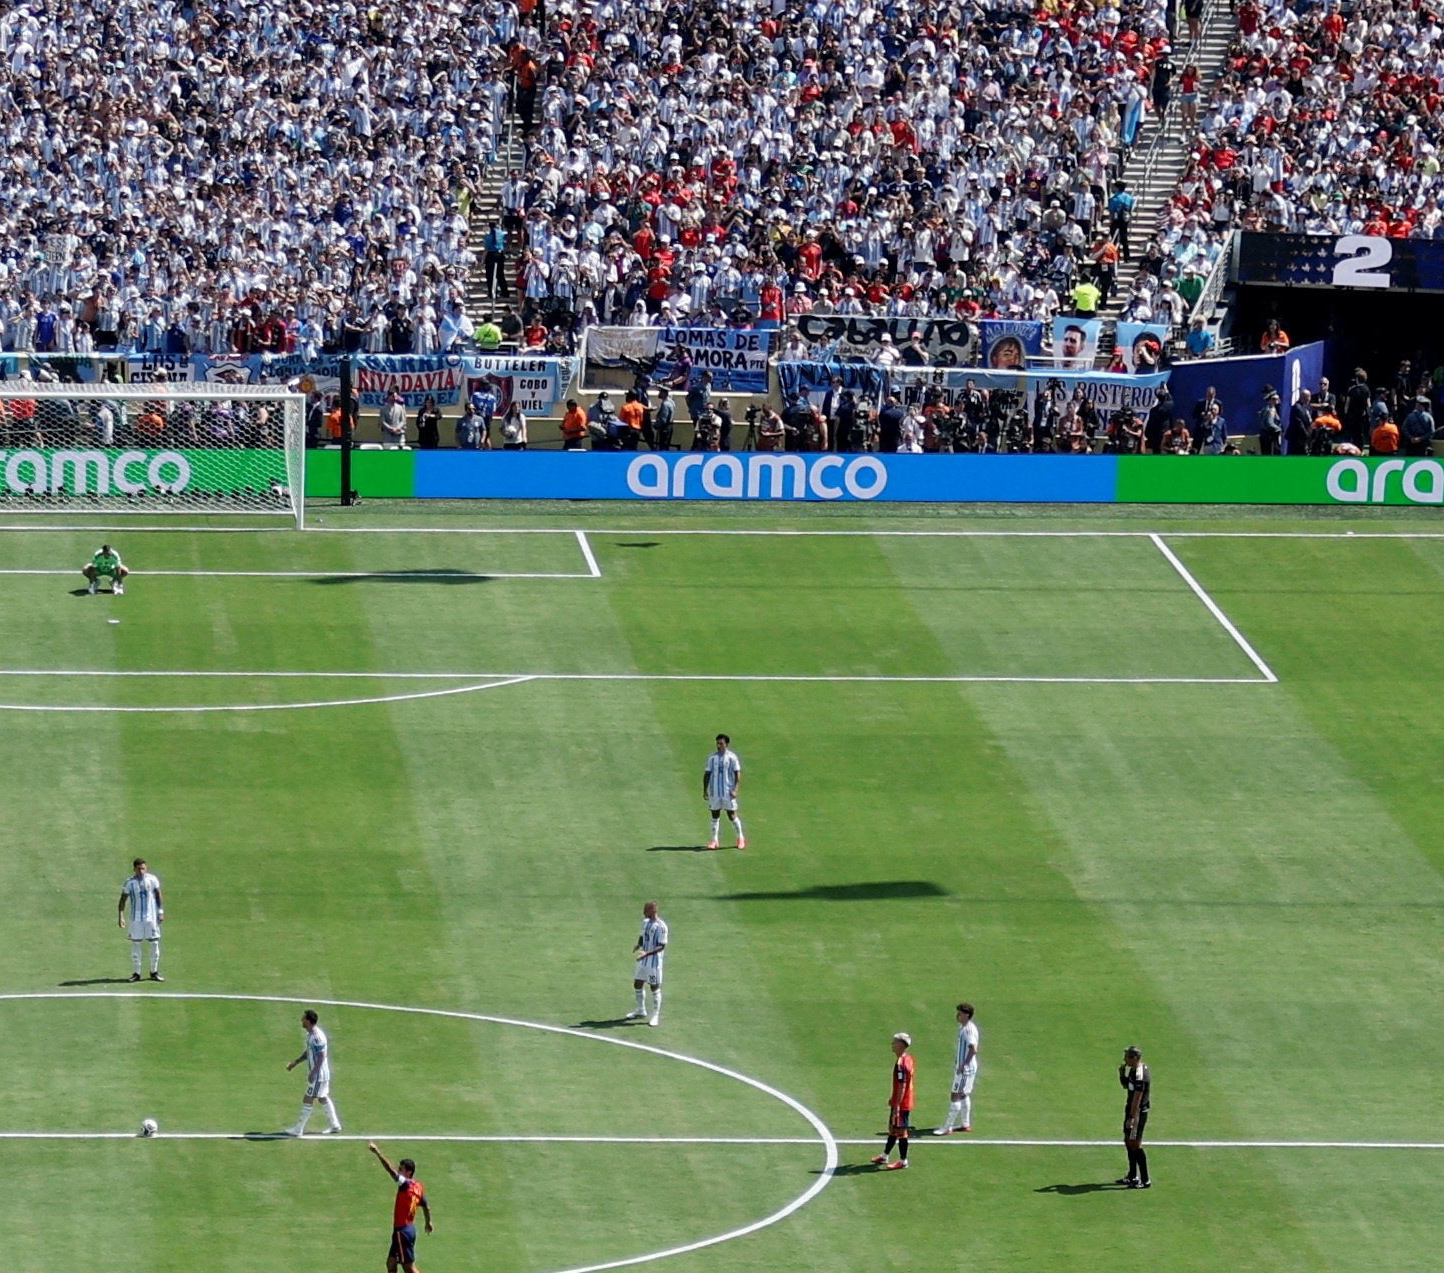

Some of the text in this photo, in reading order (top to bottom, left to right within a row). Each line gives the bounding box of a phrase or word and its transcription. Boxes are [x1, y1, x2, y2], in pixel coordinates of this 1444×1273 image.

[1331, 235, 1393, 288] 2
[664, 328, 727, 348] LOMAS
[734, 333, 760, 351] DE
[474, 357, 546, 372] BUTTELER
[358, 367, 455, 392] RIVADAVIA
[519, 378, 548, 390] COBO
[626, 454, 888, 500] aramco
